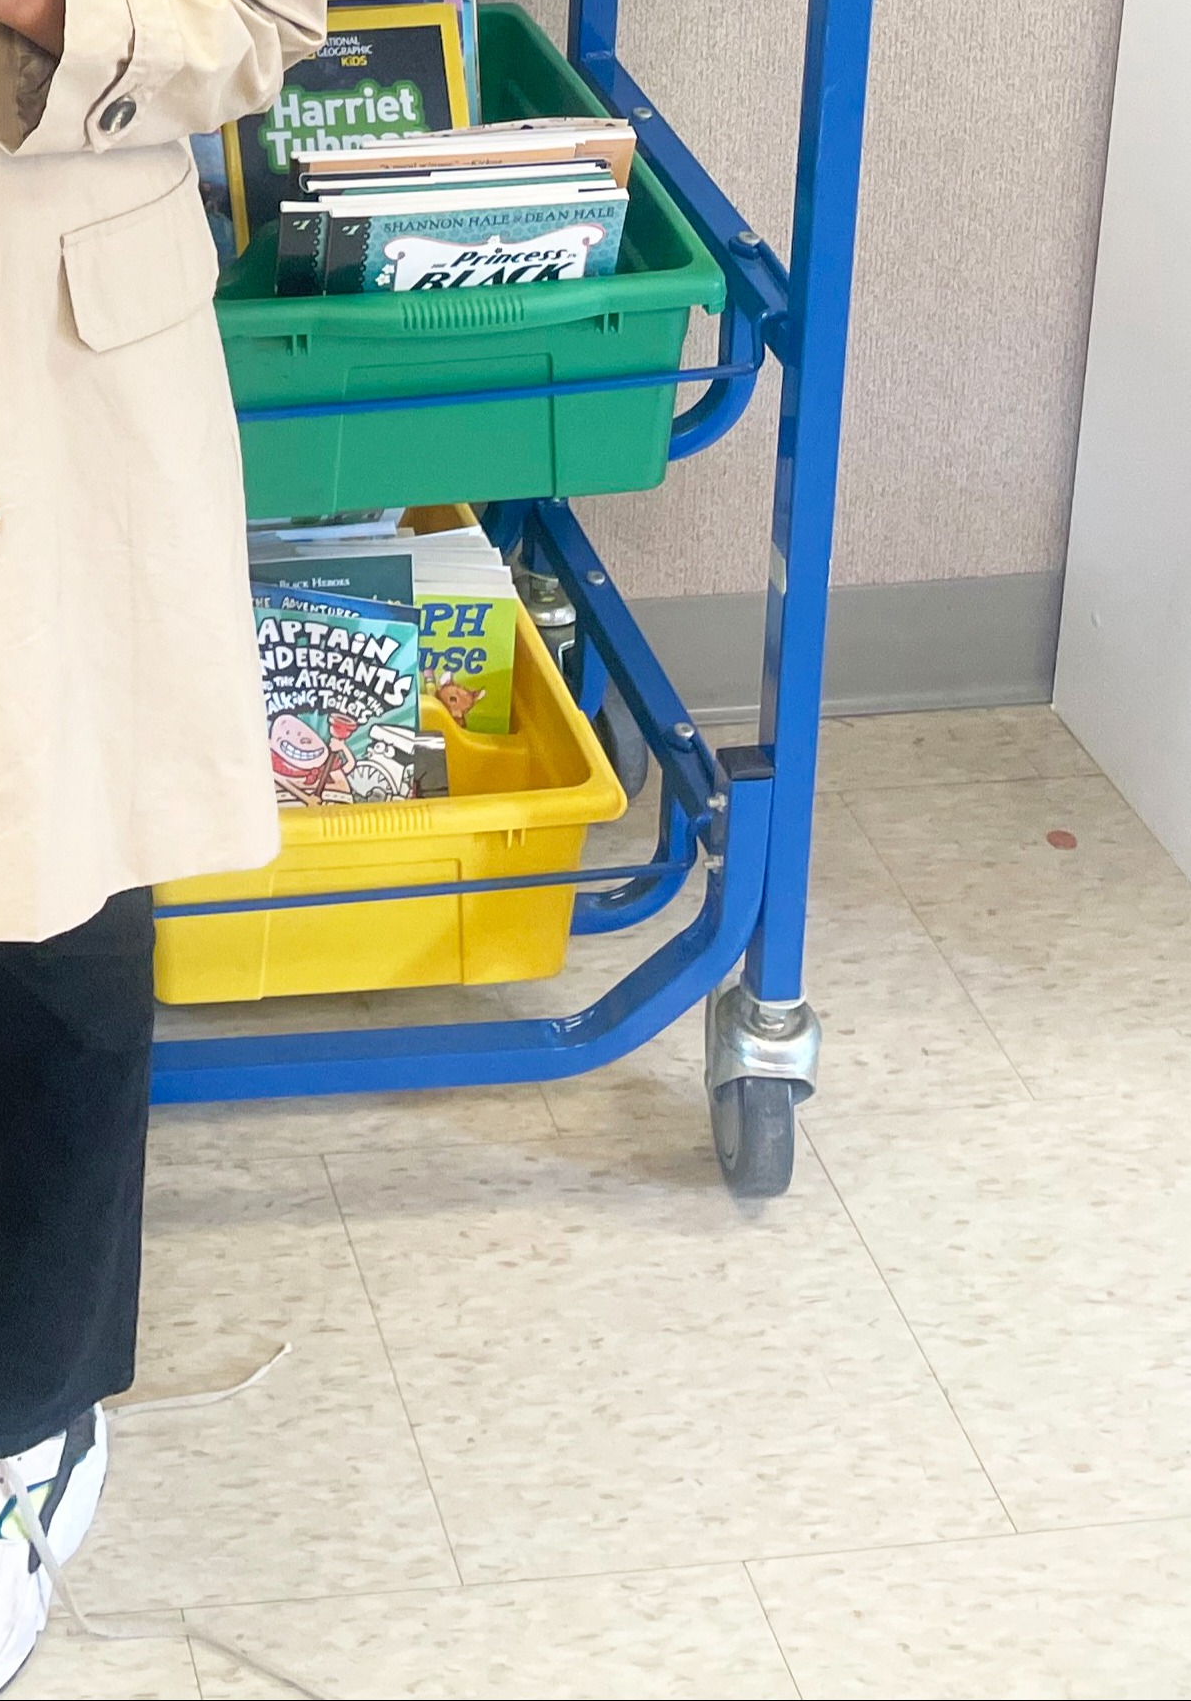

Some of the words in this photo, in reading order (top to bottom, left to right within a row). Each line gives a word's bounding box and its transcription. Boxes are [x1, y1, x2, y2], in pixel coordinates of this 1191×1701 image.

[316, 45, 373, 58] GEOGRAPHIC
[324, 36, 360, 47] ATIONAL
[274, 87, 417, 129] Harriet
[266, 128, 426, 166] Tubm
[384, 215, 466, 232] SHANNON
[468, 213, 509, 227] HALE
[525, 209, 570, 223] DEAN
[572, 207, 615, 220] HALE
[451, 247, 567, 268] Princess
[259, 645, 413, 706] NDERPANTS
[295, 669, 352, 695] ATTACK
